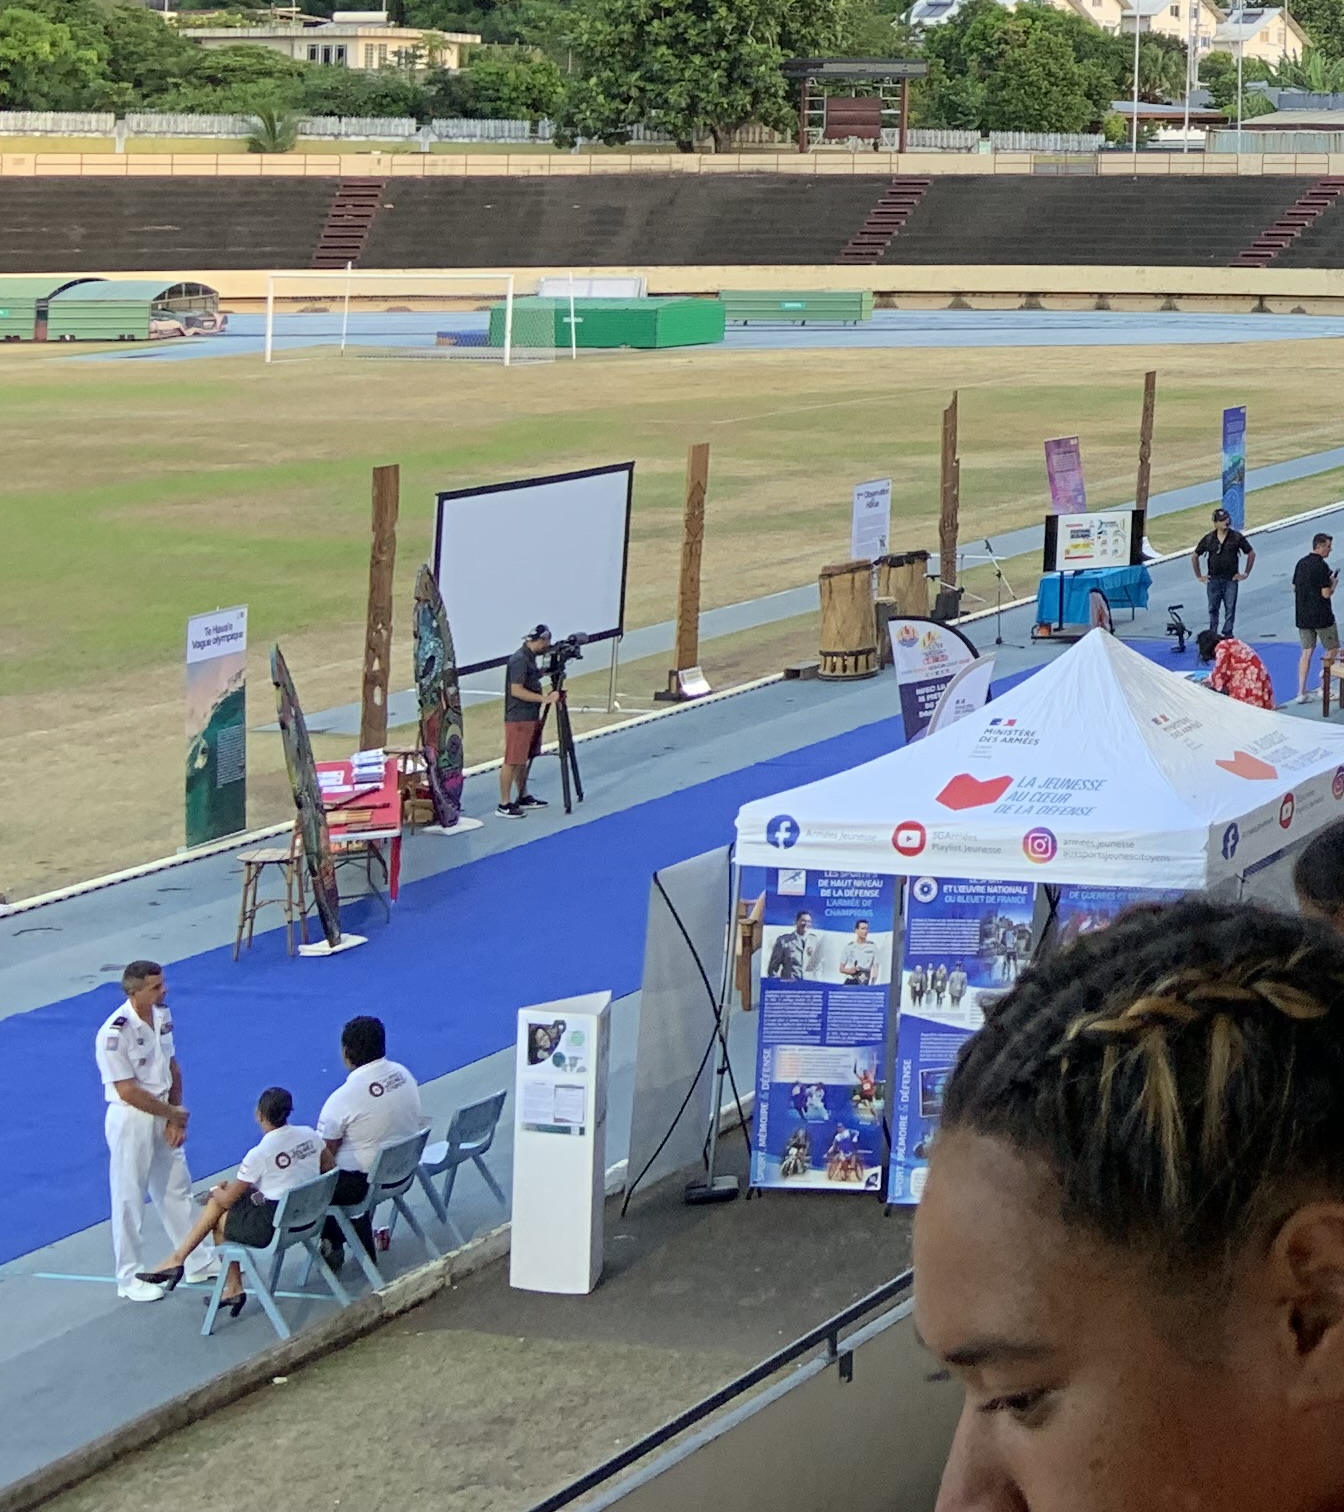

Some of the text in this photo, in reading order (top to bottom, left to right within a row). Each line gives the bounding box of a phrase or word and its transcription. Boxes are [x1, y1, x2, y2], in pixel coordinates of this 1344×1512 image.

[983, 727, 1037, 737] MINISTÈRE
[979, 735, 1040, 746] DES ARMÉES
[1017, 776, 1108, 791] LA JEUNESSE
[1005, 790, 1072, 804] AU CŒUR
[993, 803, 1011, 814] DE
[1015, 804, 1033, 815] LA
[818, 879, 883, 888] DE HAUT NIVEAU
[820, 889, 831, 897] DE
[833, 889, 843, 897] LA
